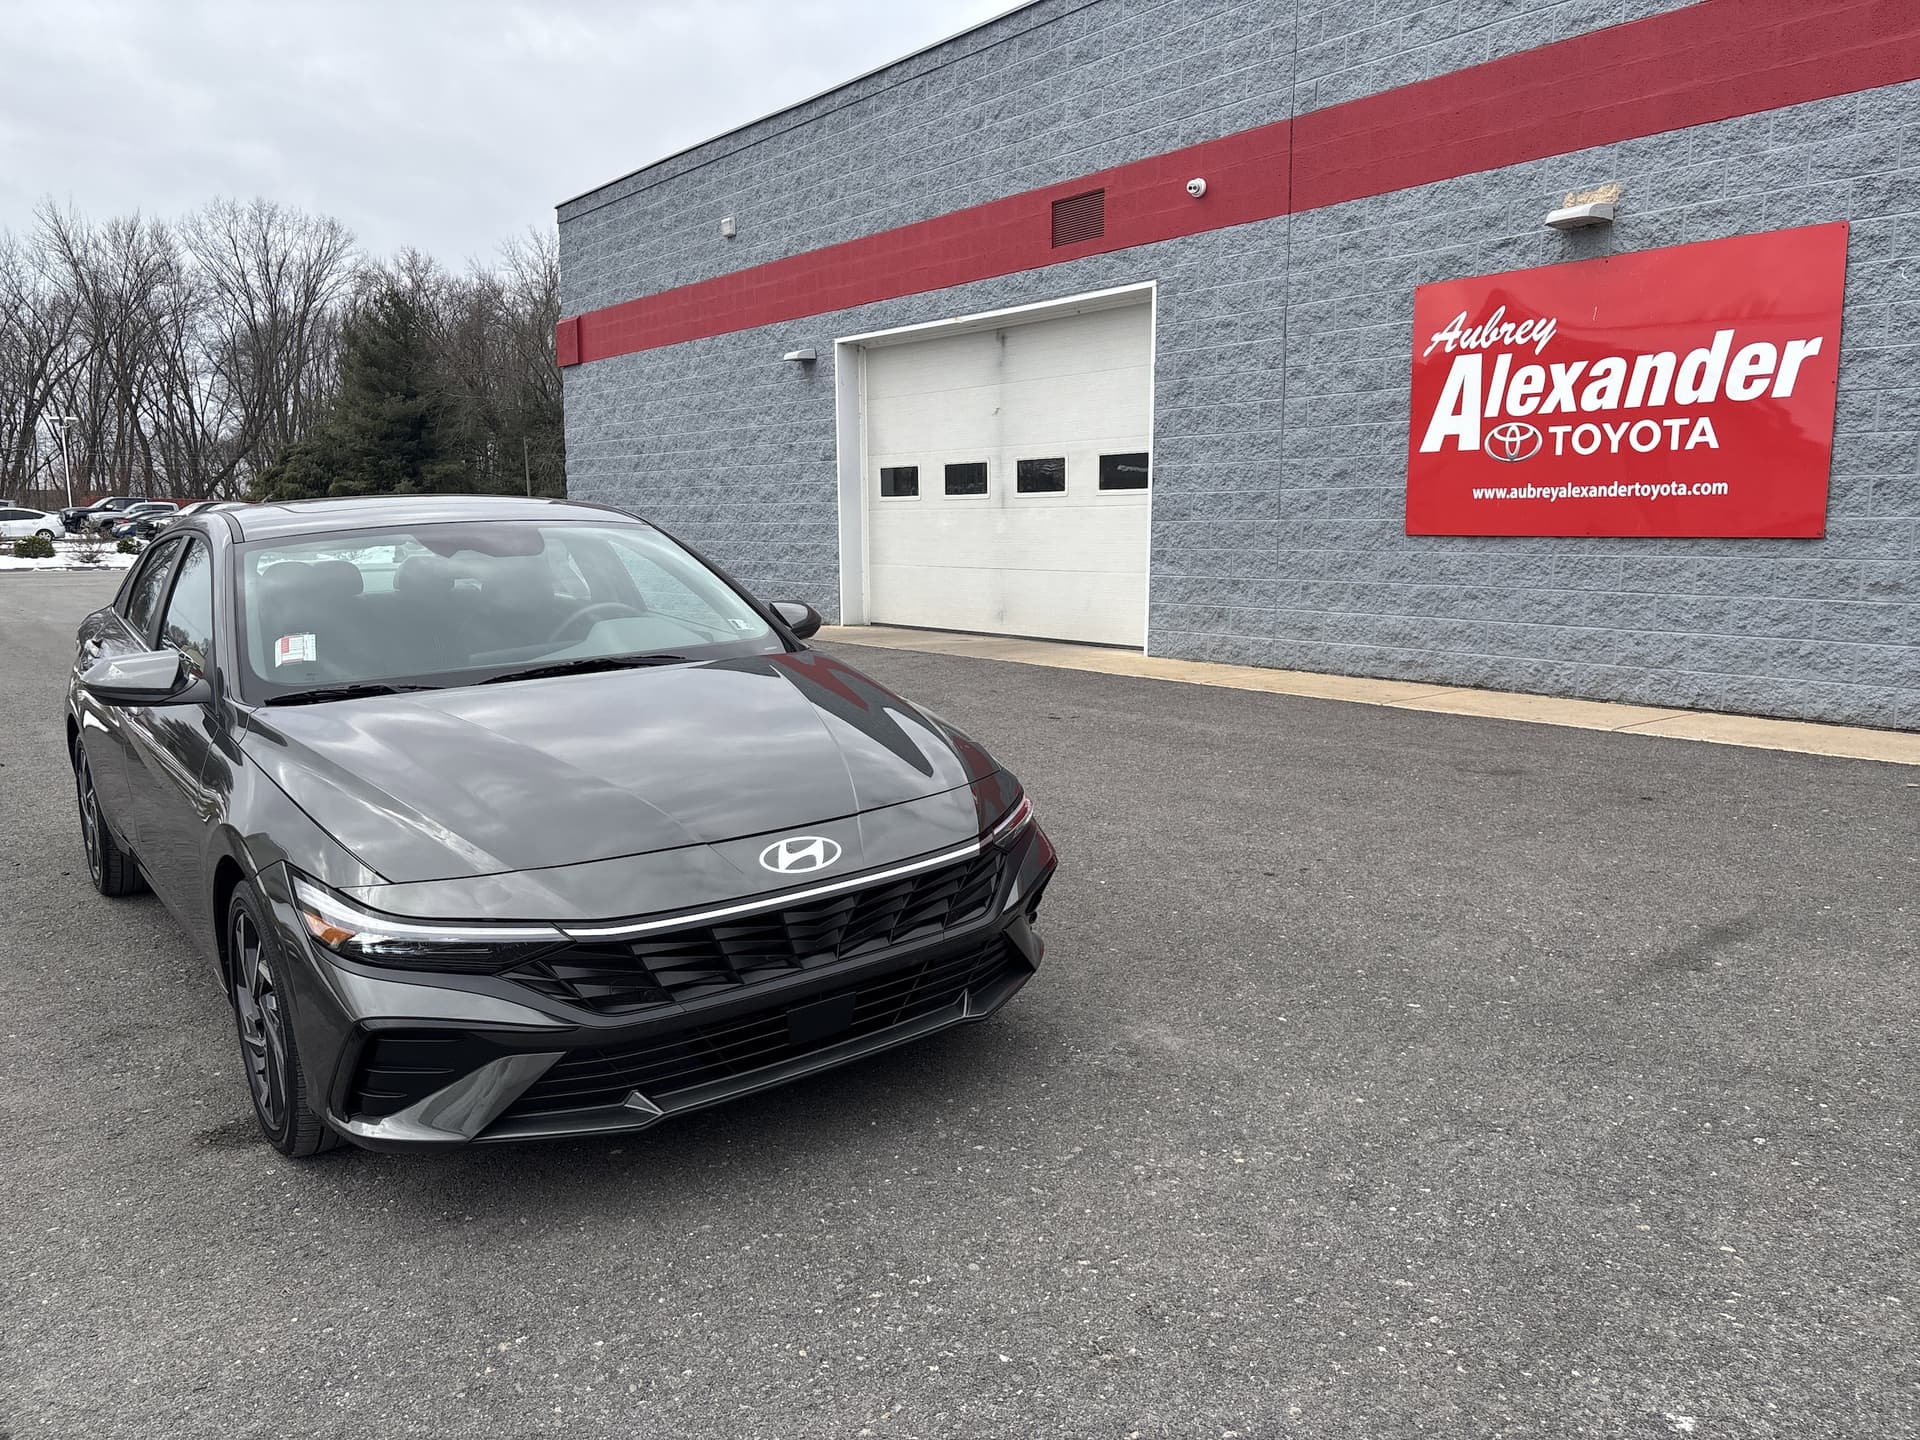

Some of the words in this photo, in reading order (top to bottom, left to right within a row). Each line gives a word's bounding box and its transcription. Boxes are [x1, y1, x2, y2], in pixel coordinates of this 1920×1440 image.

[1423, 305, 1557, 357] Aubrey
[1420, 329, 1824, 453] Alexander
[1549, 417, 1720, 456] TOYOTA
[1472, 480, 1729, 502] www.aubreyalexandertoyota.com
